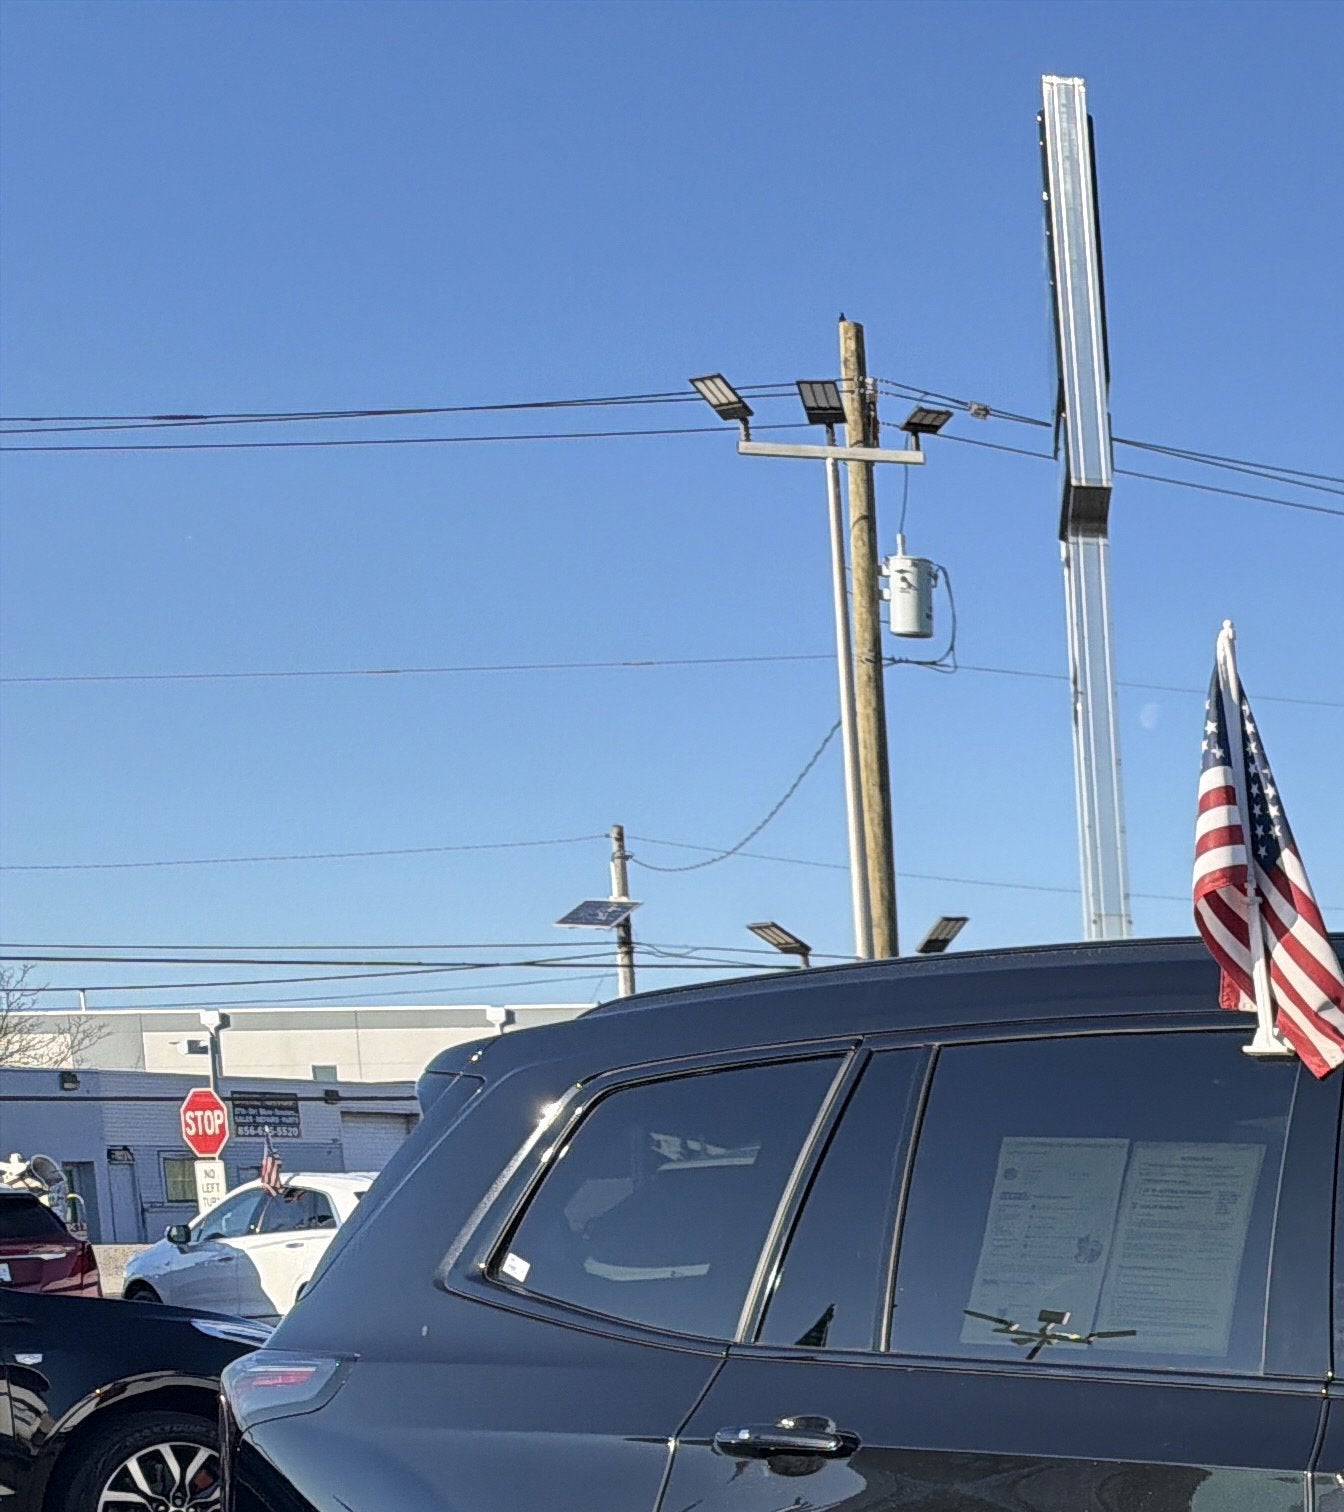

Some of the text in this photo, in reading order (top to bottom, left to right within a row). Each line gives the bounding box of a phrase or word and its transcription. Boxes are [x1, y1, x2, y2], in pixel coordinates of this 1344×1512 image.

[185, 1110, 224, 1136] STOP
[237, 1126, 299, 1136] 856-65-5520
[204, 1169, 216, 1178] NO
[201, 1183, 220, 1193] LEFT
[202, 1196, 221, 1206] TUR
